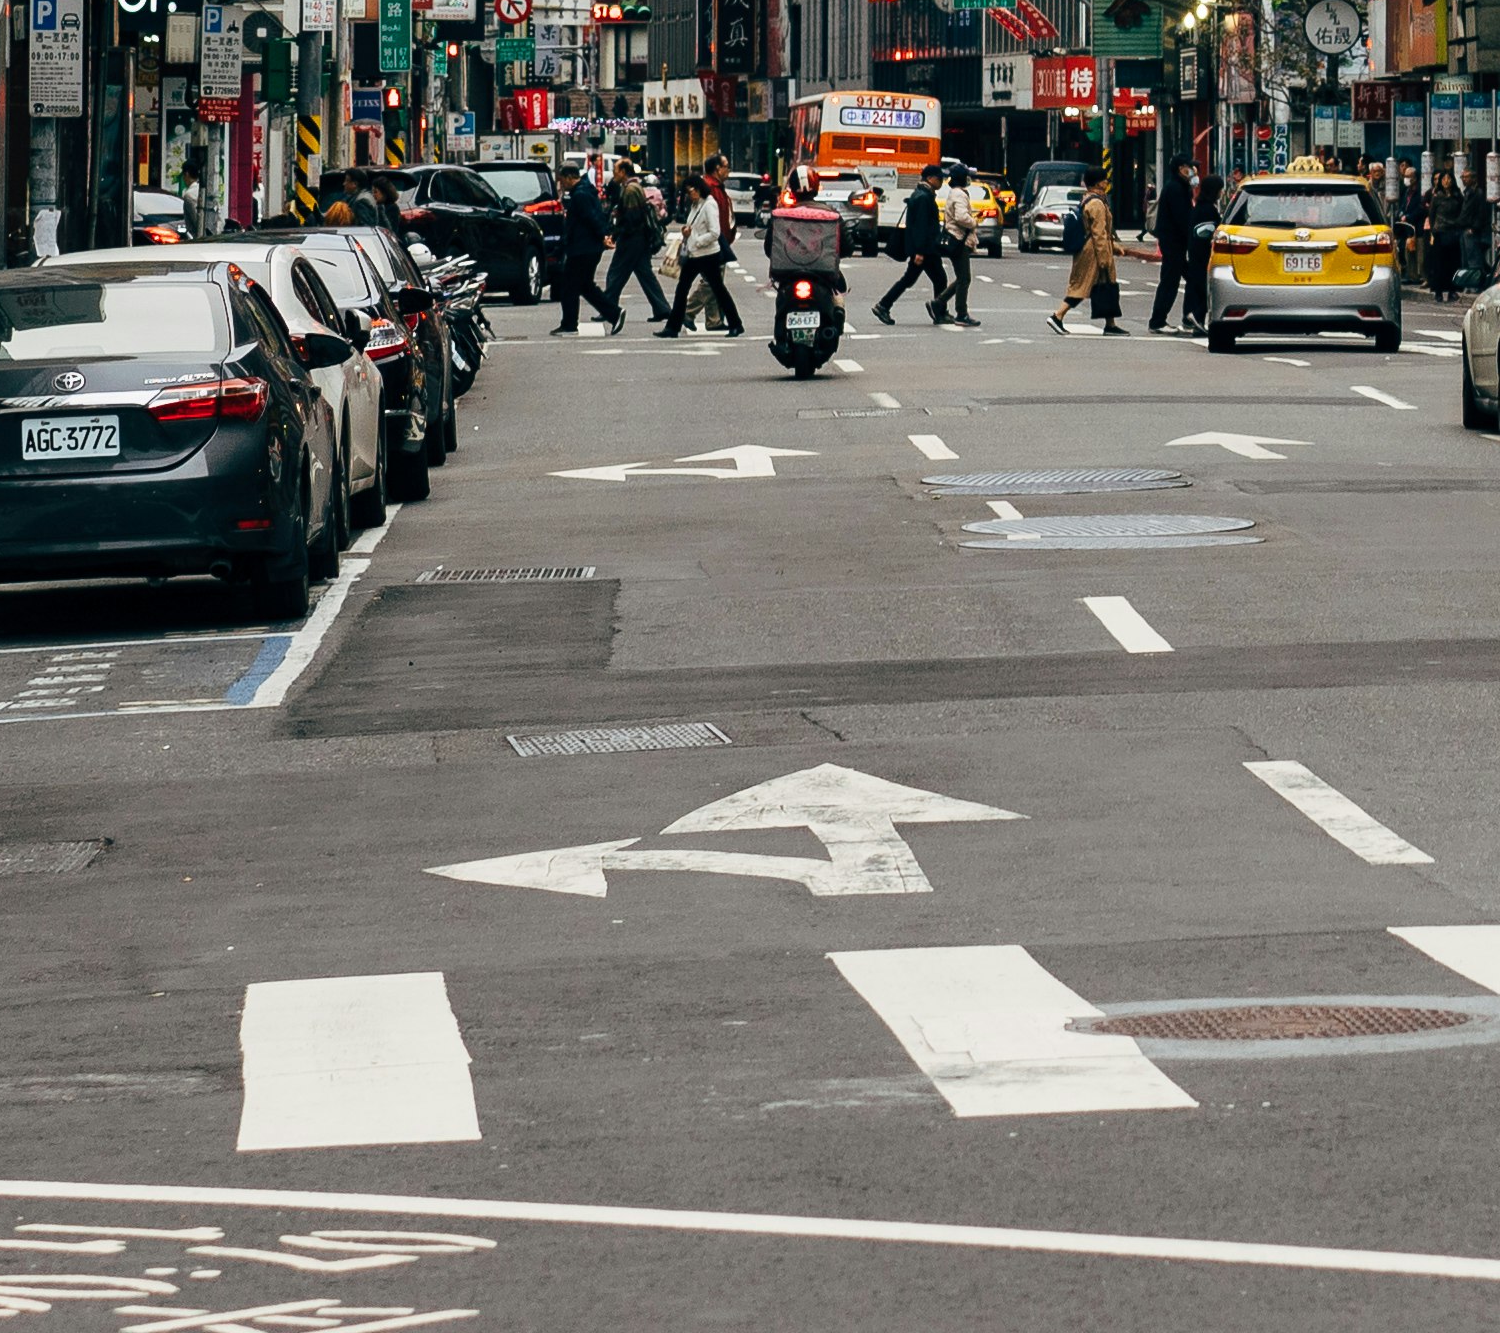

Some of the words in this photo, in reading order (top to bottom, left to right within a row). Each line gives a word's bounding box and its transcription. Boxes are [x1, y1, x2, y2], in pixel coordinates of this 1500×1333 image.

[31, 52, 80, 61] 09:00-17:00
[873, 111, 893, 125] 241
[177, 372, 216, 383] ALTIS
